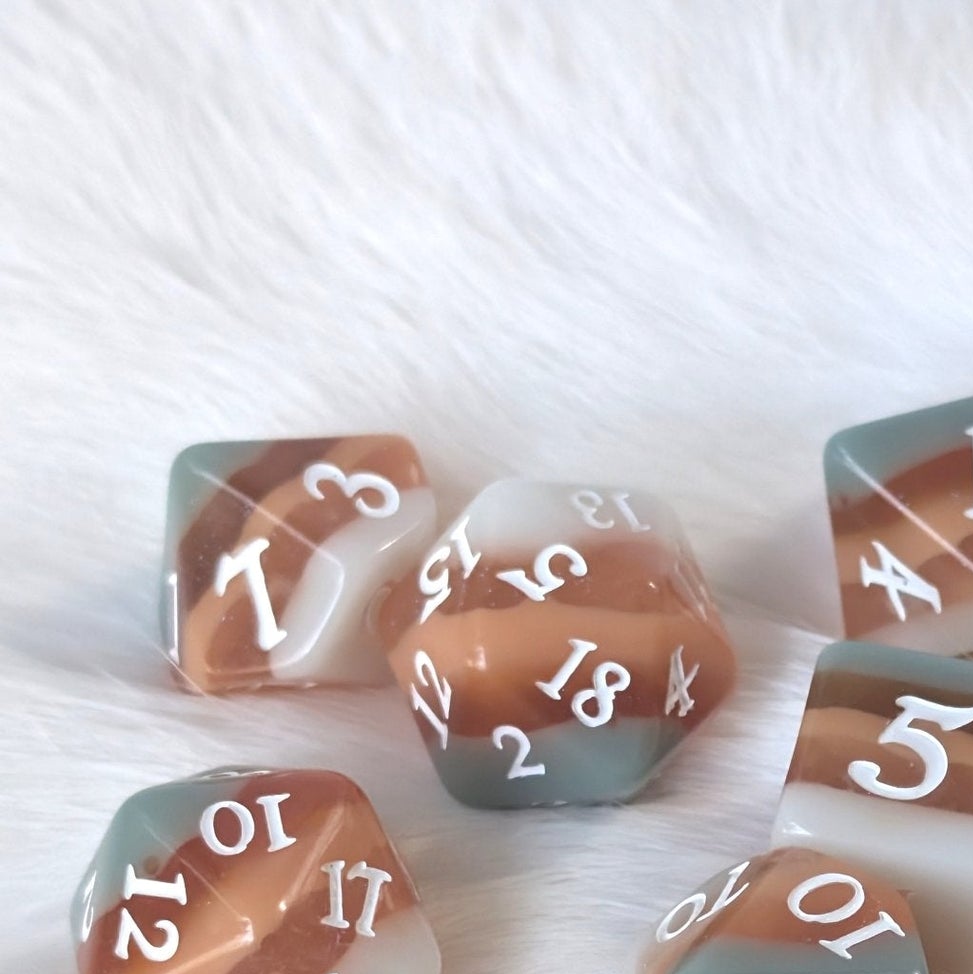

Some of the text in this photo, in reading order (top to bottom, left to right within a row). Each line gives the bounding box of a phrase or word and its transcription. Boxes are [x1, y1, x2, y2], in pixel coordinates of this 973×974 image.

[304, 462, 400, 518] 3
[572, 490, 650, 533] 13
[215, 538, 288, 651] 7
[418, 516, 482, 624] 15
[497, 544, 588, 601] 5
[860, 540, 942, 622] 4
[410, 650, 452, 750] 12
[536, 638, 630, 728] 18
[665, 645, 699, 717] 4
[492, 725, 545, 780] 2
[199, 793, 296, 856] 10
[114, 863, 187, 962] 12
[321, 860, 392, 938] 17
[788, 873, 905, 959] 10
